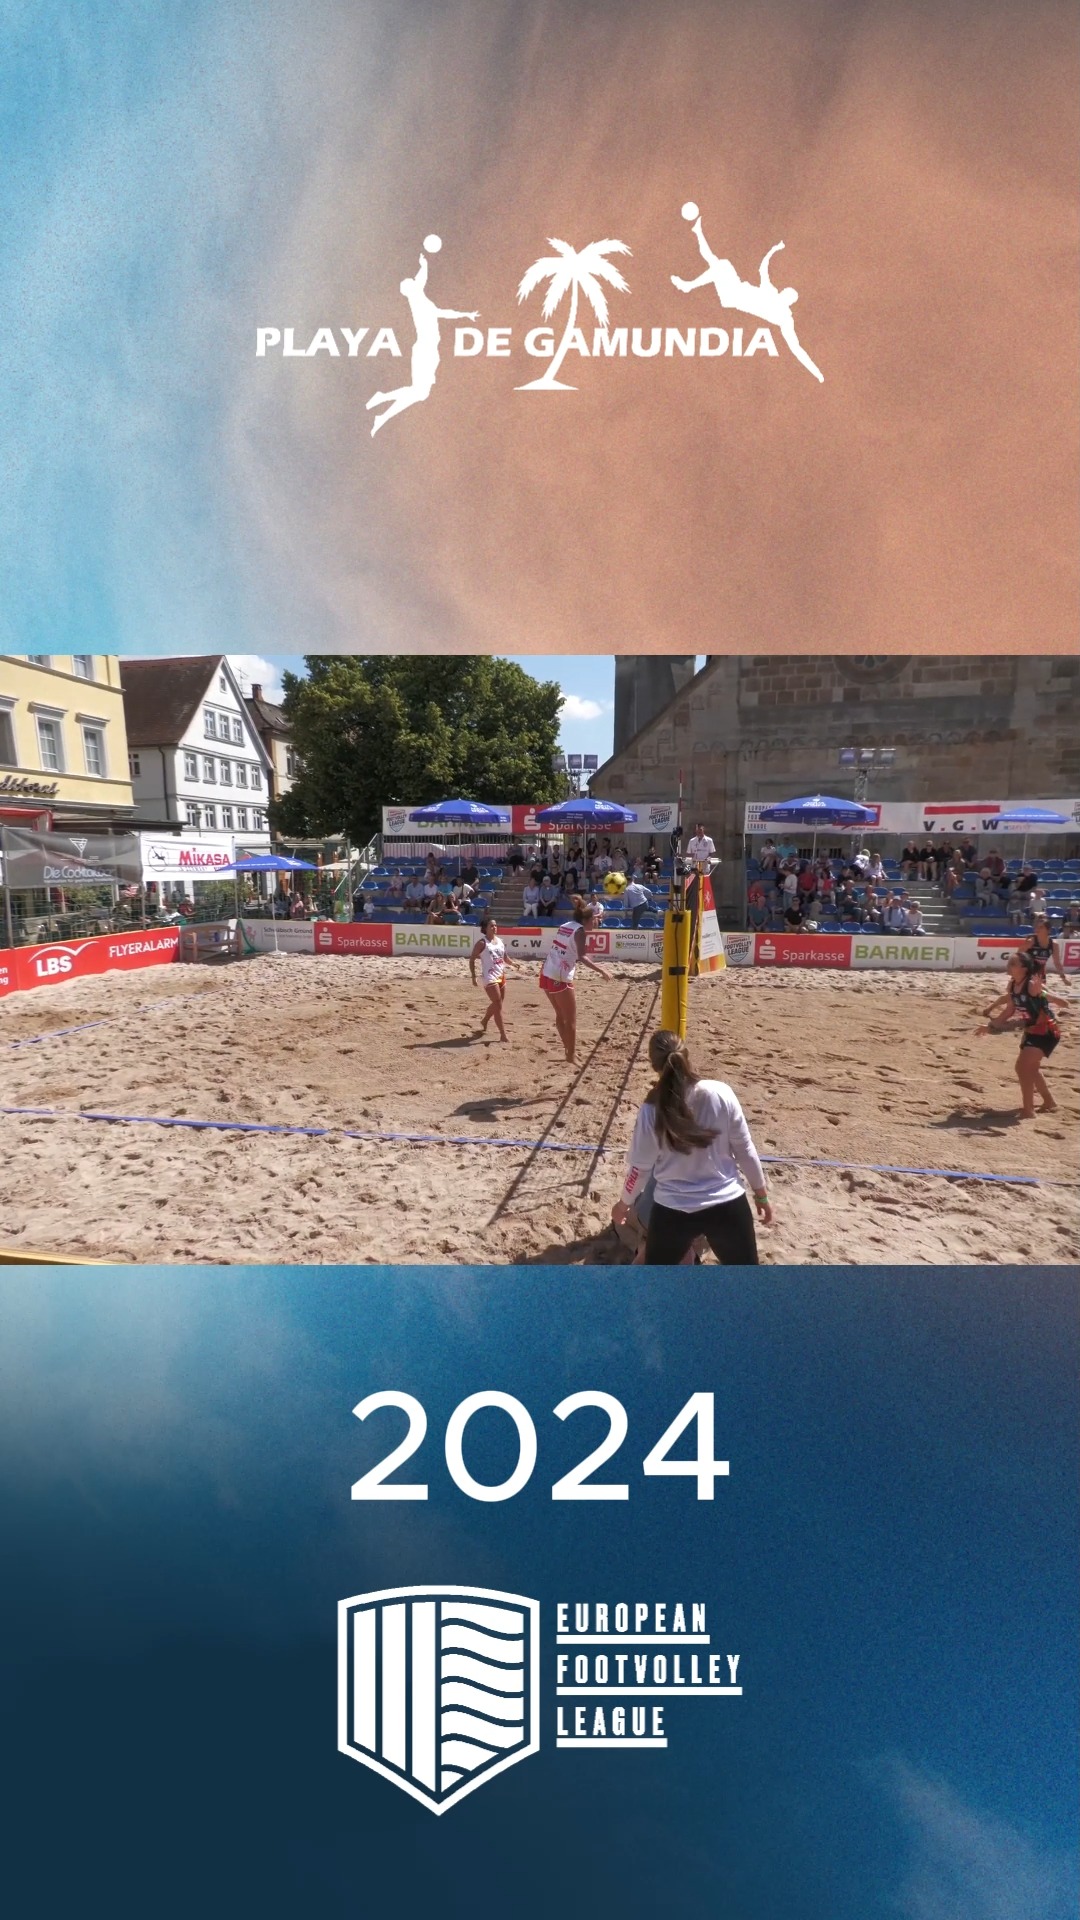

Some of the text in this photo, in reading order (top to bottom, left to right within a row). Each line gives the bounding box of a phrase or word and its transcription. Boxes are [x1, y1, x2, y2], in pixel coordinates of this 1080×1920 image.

[109, 936, 179, 958] FLYERALARM
[337, 936, 388, 948] Sparkasse
[395, 932, 471, 948] BARMER
[728, 946, 749, 955] LEAGUE
[782, 950, 845, 962] Sparkasse
[855, 945, 950, 961] BARMER
[36, 955, 73, 977] LBS
